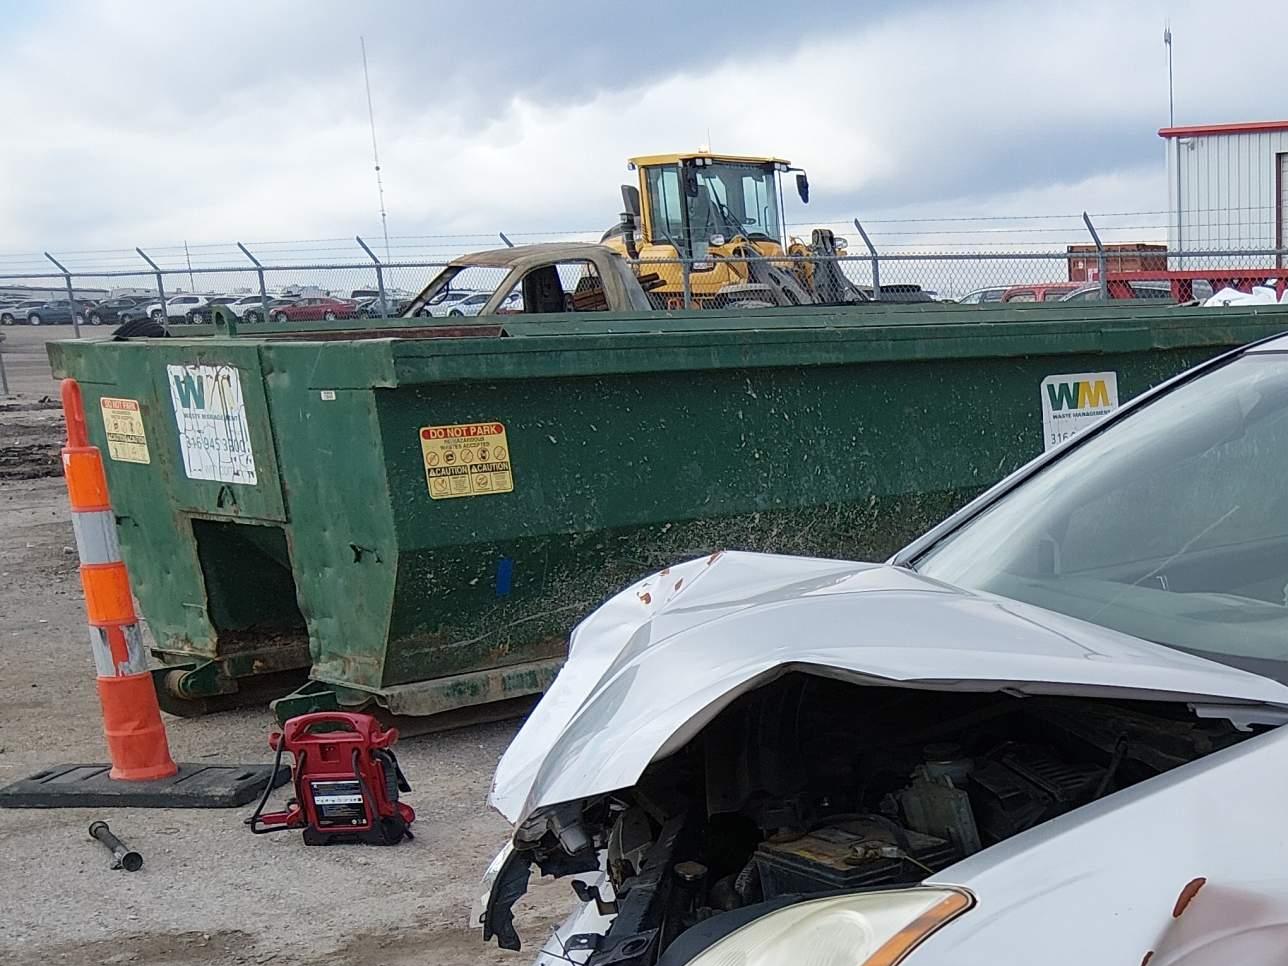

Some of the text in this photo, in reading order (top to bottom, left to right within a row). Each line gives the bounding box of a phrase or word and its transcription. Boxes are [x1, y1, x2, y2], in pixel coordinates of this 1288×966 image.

[1046, 380, 1110, 411] WM
[1073, 410, 1111, 418] MANAGEMENT
[429, 425, 497, 439] DO NOT PARK
[436, 463, 508, 476] CAUTION CAUTION
